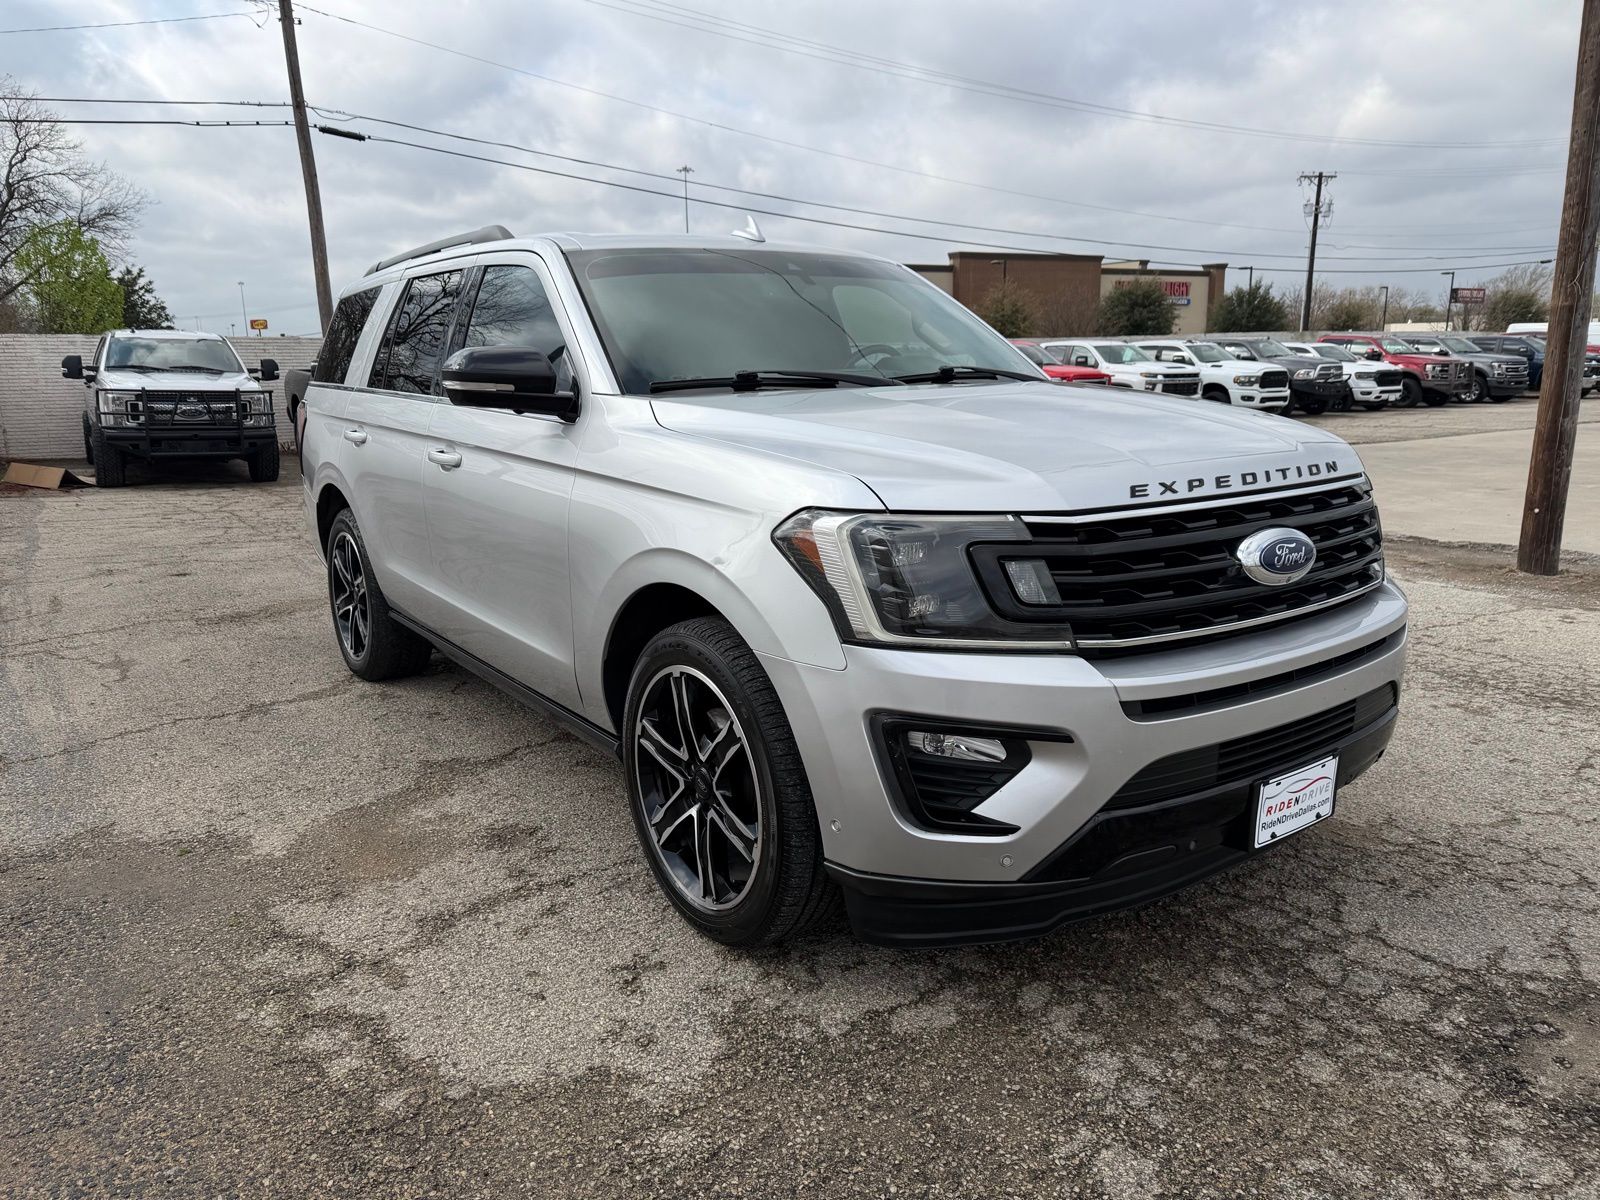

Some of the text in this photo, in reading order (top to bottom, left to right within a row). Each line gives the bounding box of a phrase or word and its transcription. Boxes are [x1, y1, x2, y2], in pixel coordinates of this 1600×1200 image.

[1129, 460, 1339, 499] EXPEDITION
[1274, 542, 1307, 568] Ford
[1261, 797, 1330, 832] RideNDriveDallas.com
